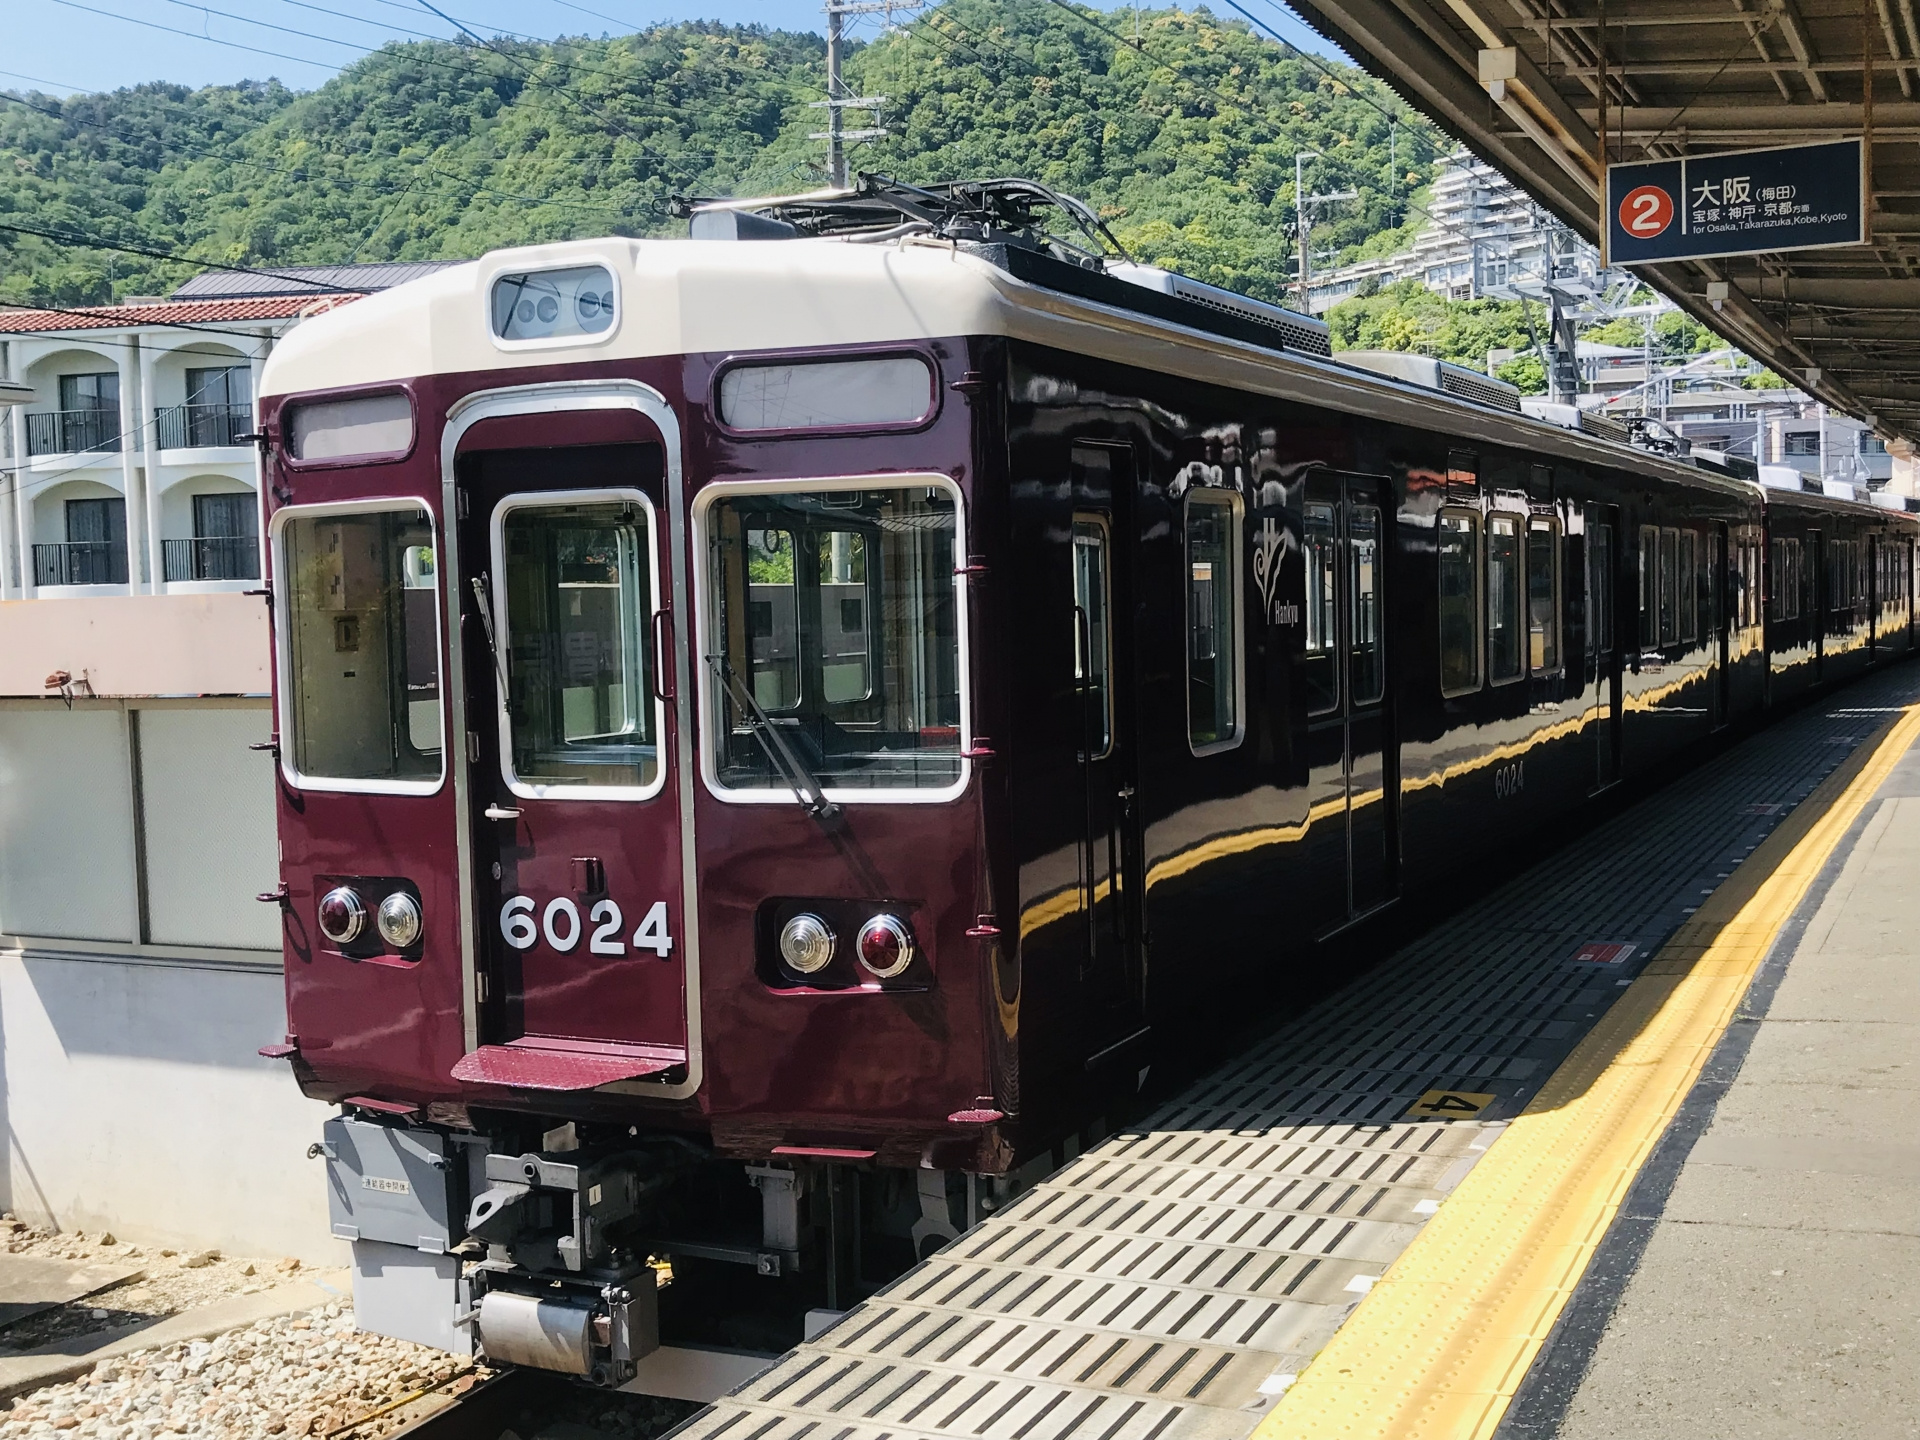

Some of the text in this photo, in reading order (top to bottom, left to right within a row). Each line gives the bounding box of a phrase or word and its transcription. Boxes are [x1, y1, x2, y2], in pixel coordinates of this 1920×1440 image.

[1631, 193, 1662, 231] 2
[1692, 225, 1706, 235] for
[1274, 599, 1299, 628] Hankyu
[1495, 760, 1524, 800] 6024
[499, 895, 674, 958] 6024
[1419, 1094, 1481, 1113] 4
